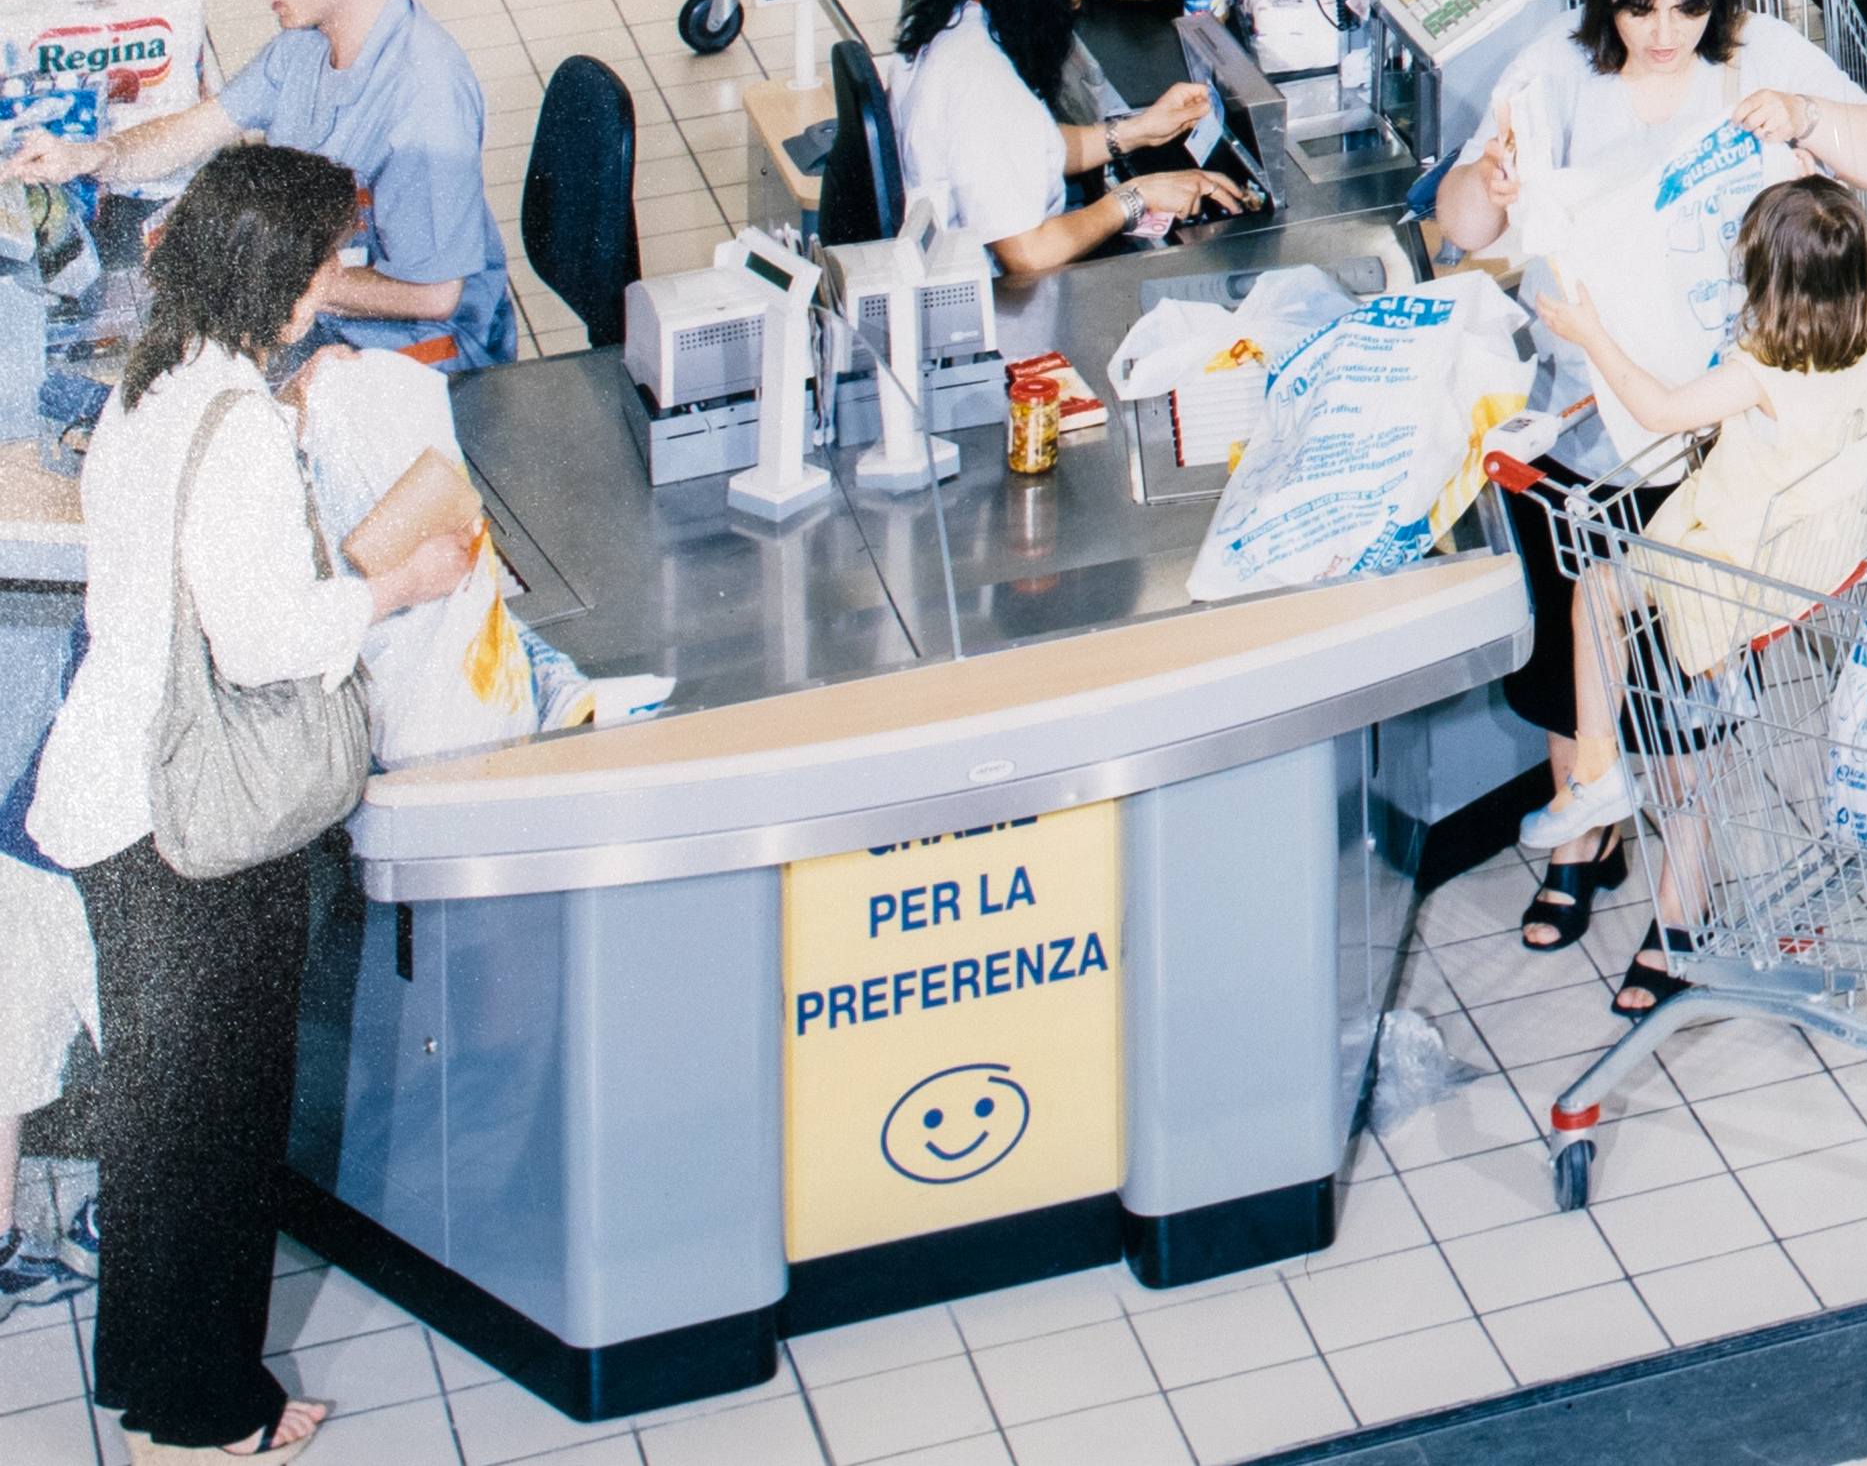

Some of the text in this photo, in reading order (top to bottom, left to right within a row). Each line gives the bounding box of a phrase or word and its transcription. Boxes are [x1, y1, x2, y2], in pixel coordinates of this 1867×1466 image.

[36, 34, 169, 75] Regina
[1403, 296, 1426, 313] fa
[869, 867, 1034, 938] PER LA
[797, 932, 1107, 1036] PREFERENZA
